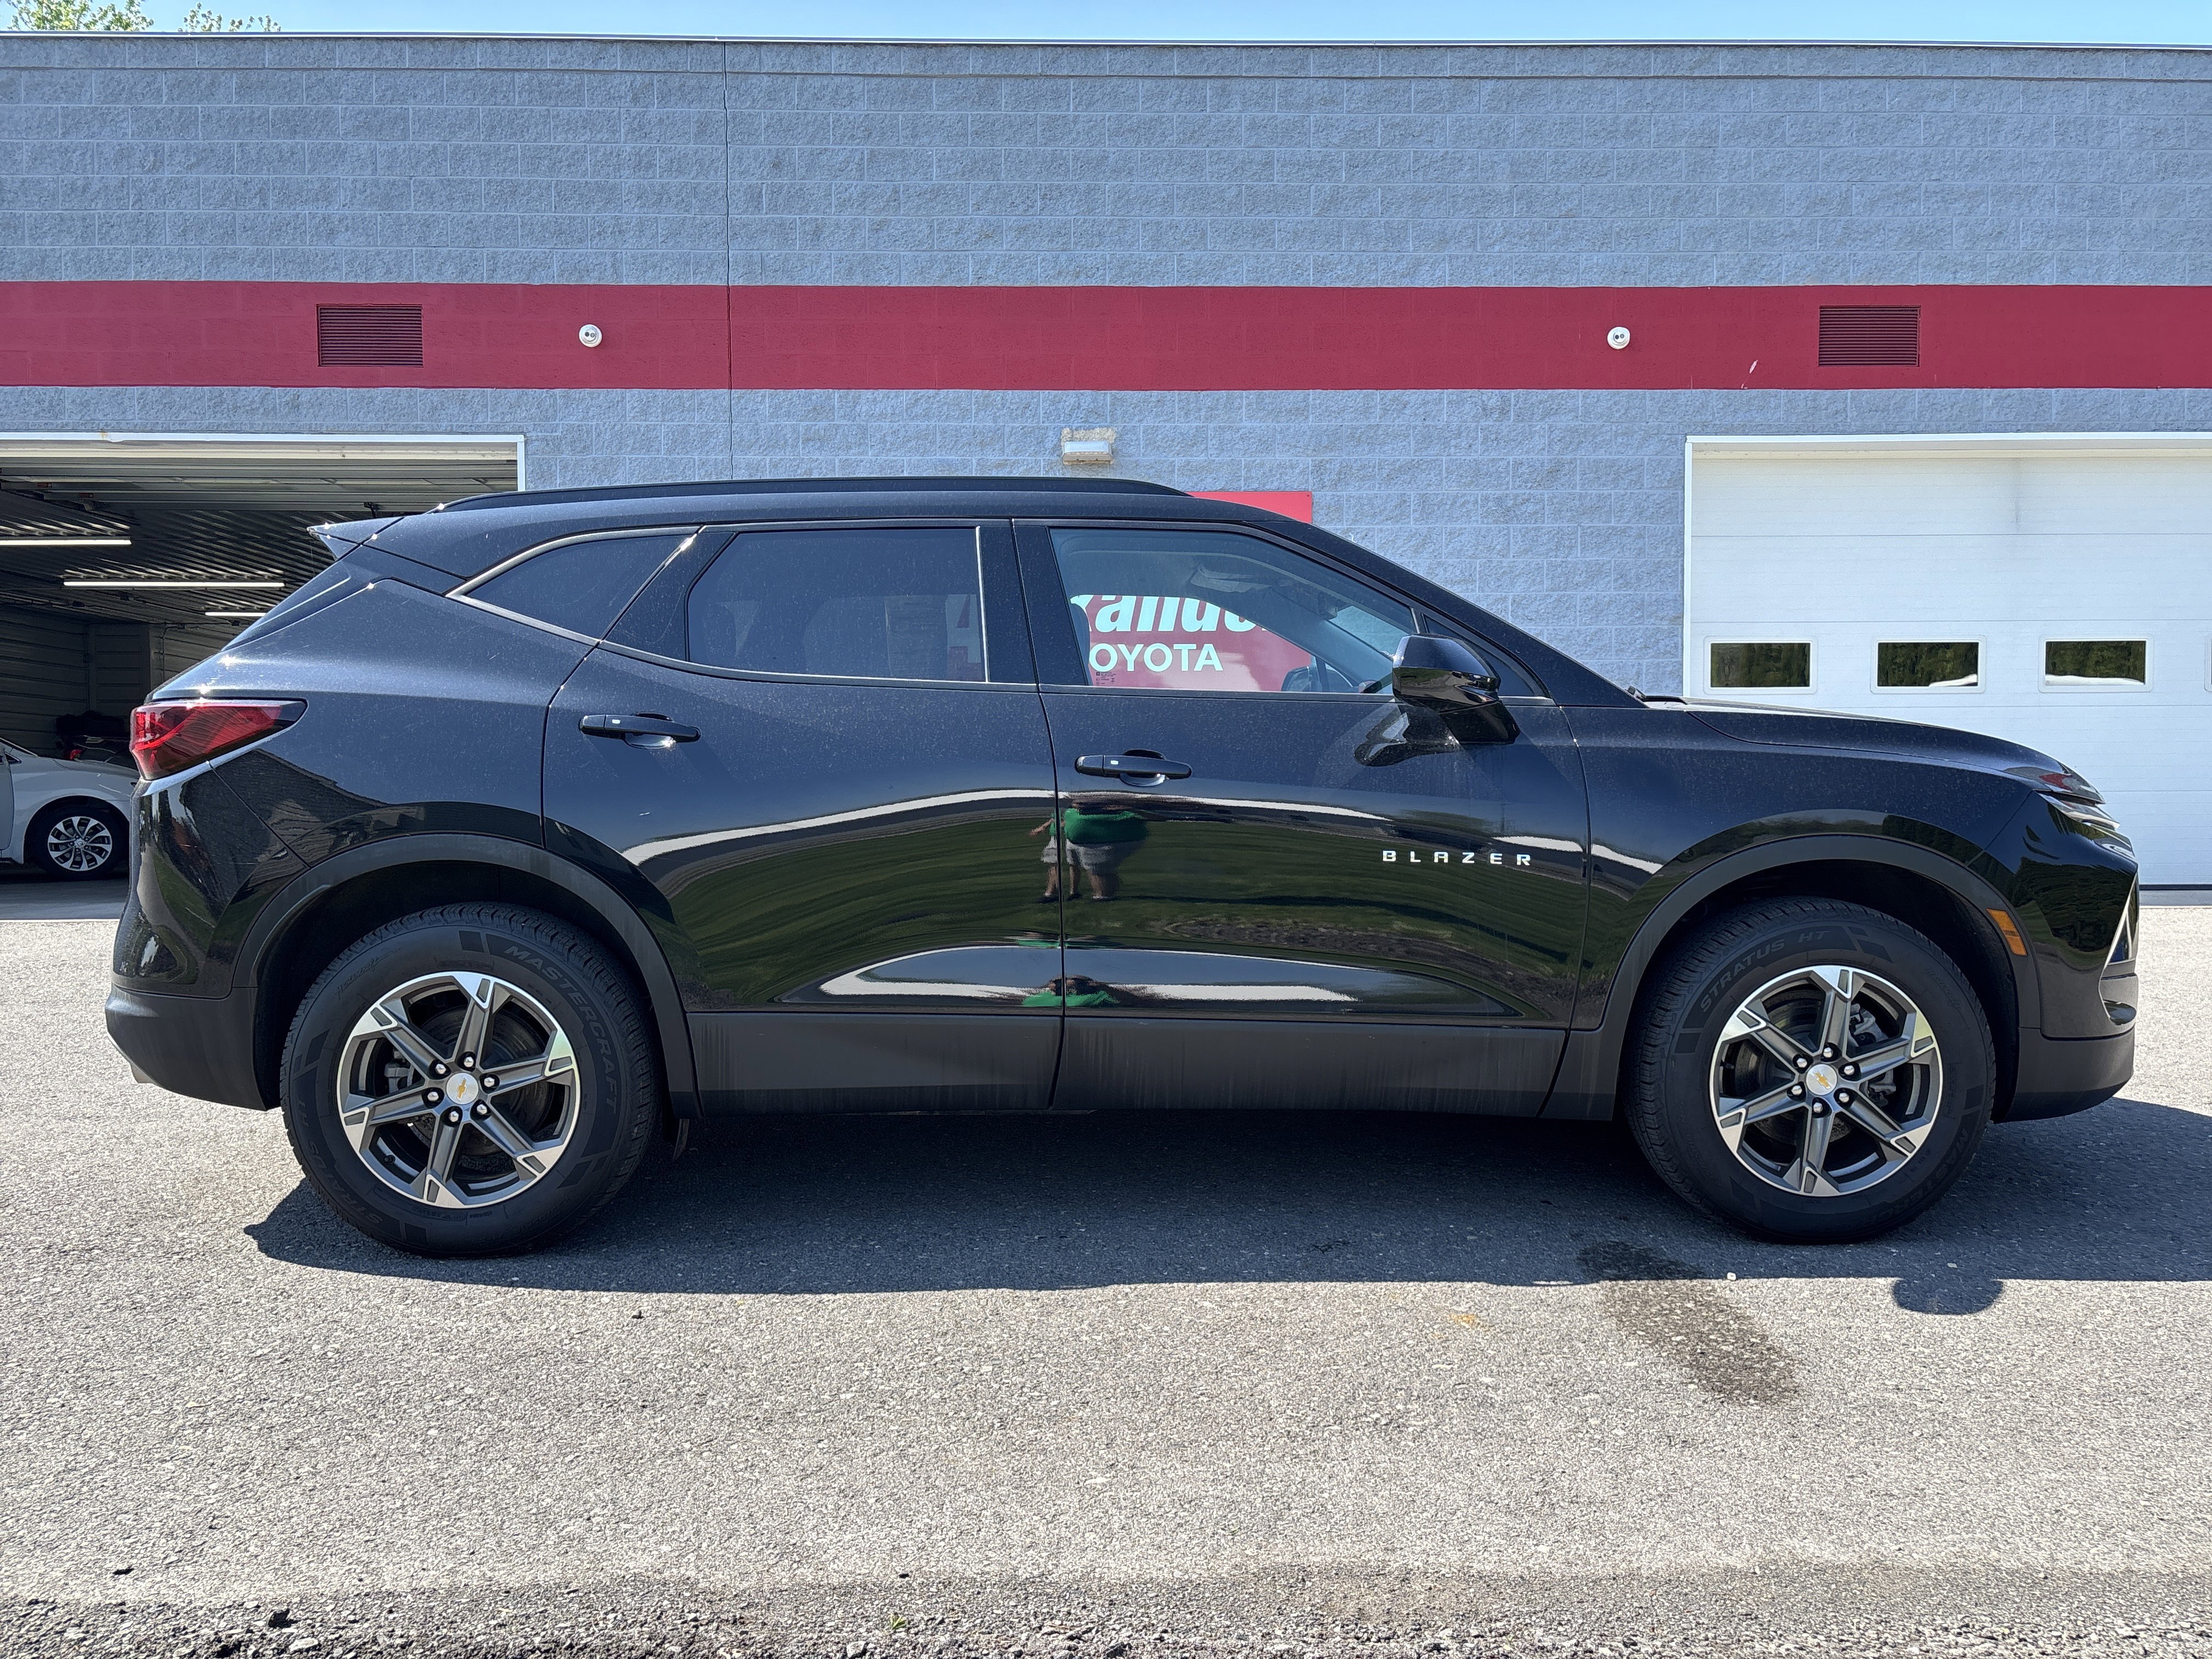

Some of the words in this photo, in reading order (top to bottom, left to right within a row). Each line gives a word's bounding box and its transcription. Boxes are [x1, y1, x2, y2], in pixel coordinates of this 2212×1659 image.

[1089, 643, 1223, 672] OYOTA
[1383, 850, 1531, 866] BLAZER
[1700, 938, 1785, 1013] STRATUS
[1798, 930, 1831, 943] HT
[504, 945, 618, 1114] MASTERCRAFT
[307, 1140, 383, 1224] STRATUS
